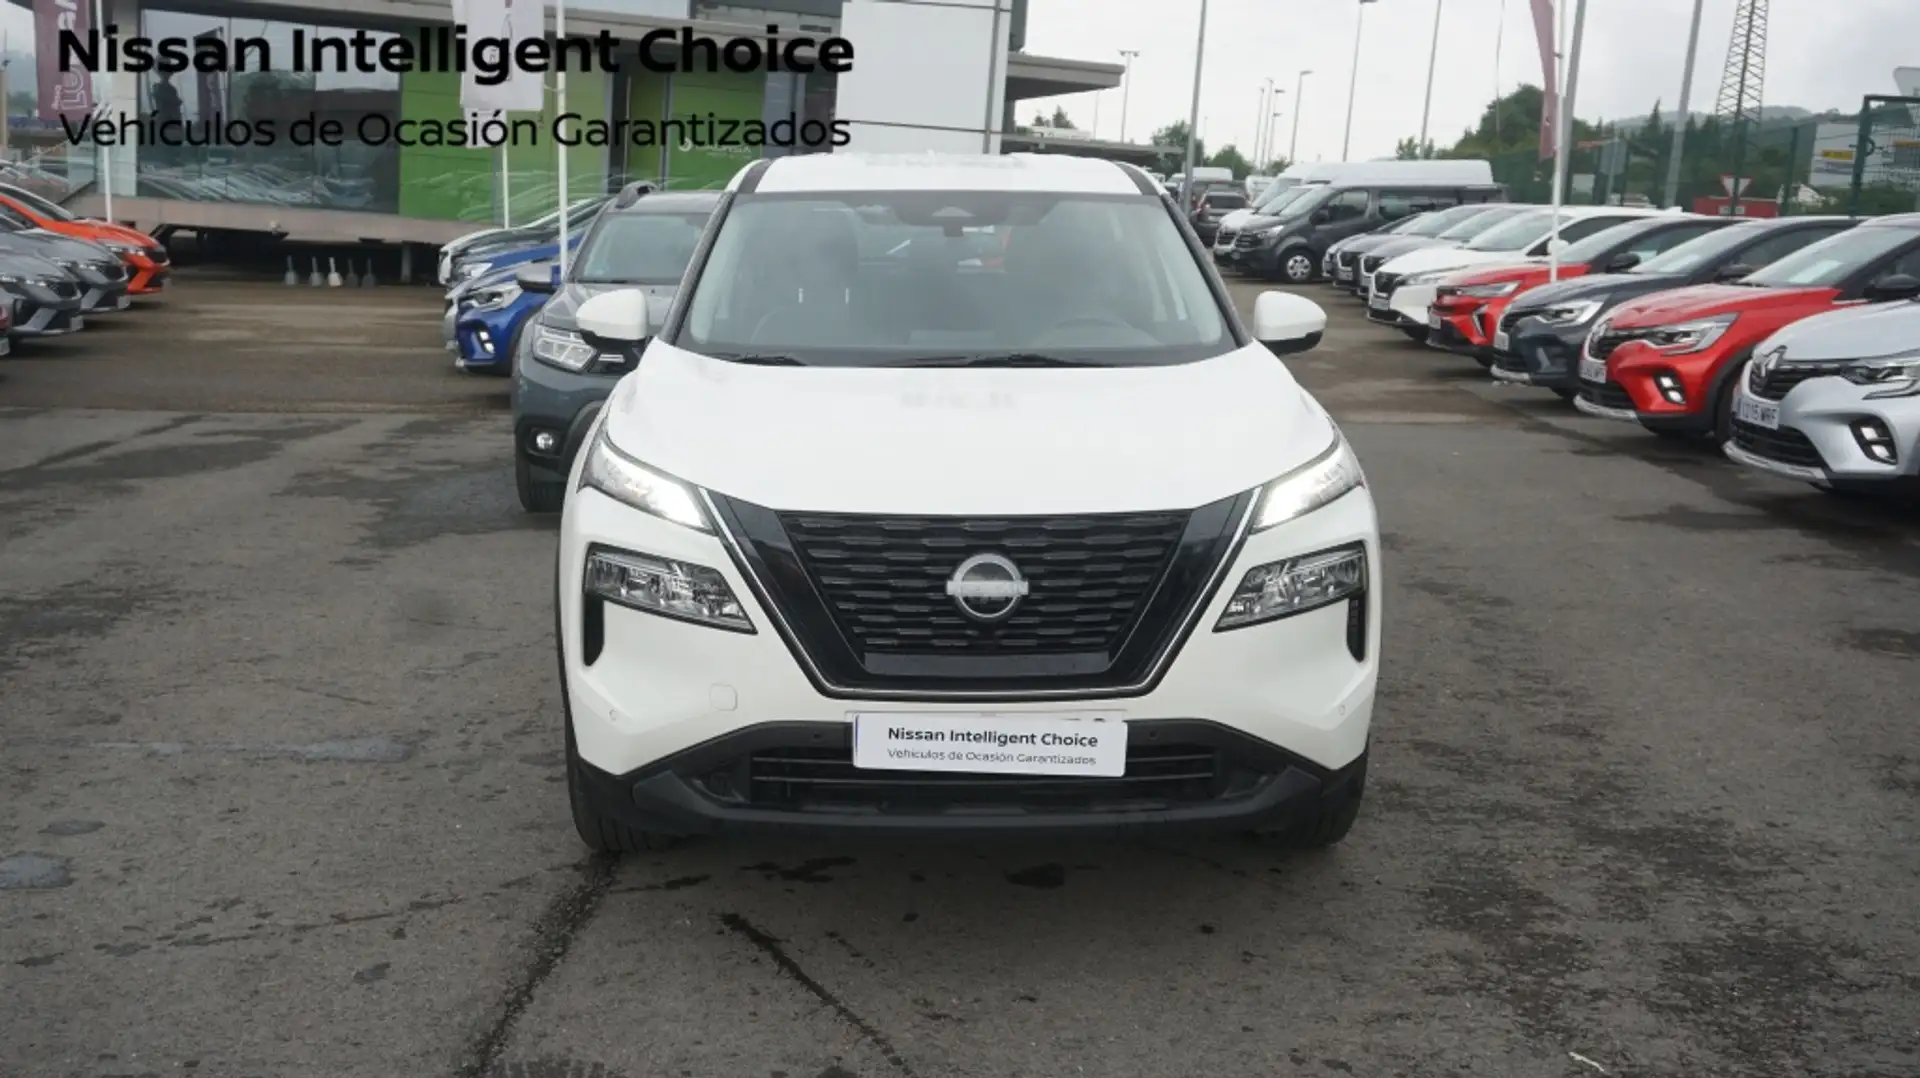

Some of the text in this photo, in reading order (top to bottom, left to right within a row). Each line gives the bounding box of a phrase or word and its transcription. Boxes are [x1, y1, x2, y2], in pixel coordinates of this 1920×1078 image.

[888, 727, 1098, 748] Nissan Intelligent Choice
[948, 750, 963, 761] de
[1017, 753, 1097, 766] Garantizados
